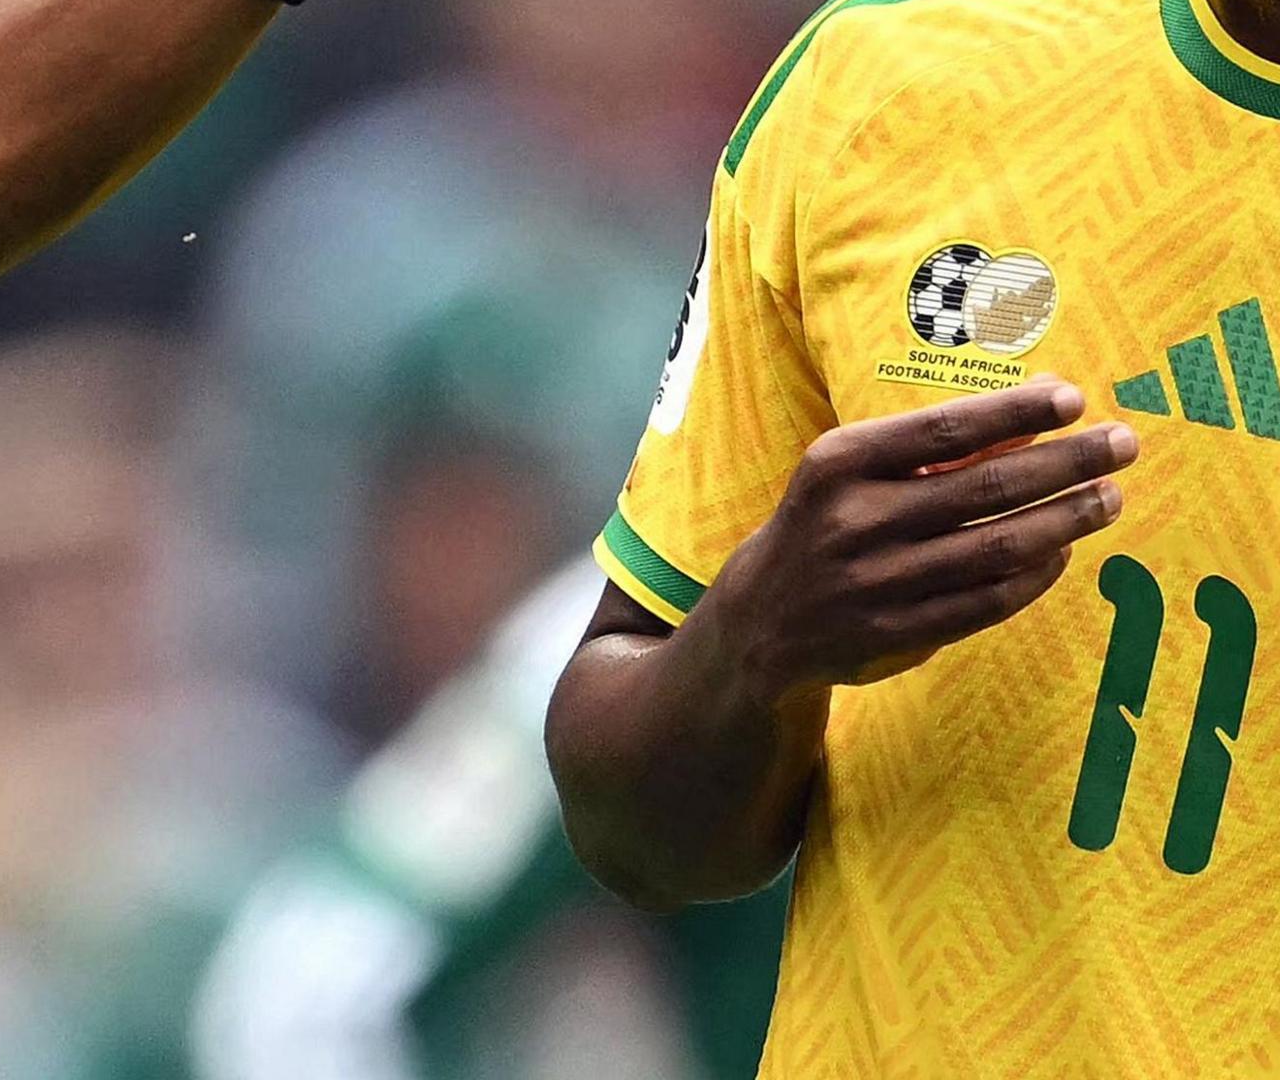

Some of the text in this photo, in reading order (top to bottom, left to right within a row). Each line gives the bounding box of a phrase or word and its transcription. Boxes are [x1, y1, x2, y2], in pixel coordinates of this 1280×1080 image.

[877, 363, 1020, 391] FOOTBALL ASSOCIA
[908, 350, 1022, 377] SOUTH AFRICAN
[1066, 553, 1258, 876] 11
